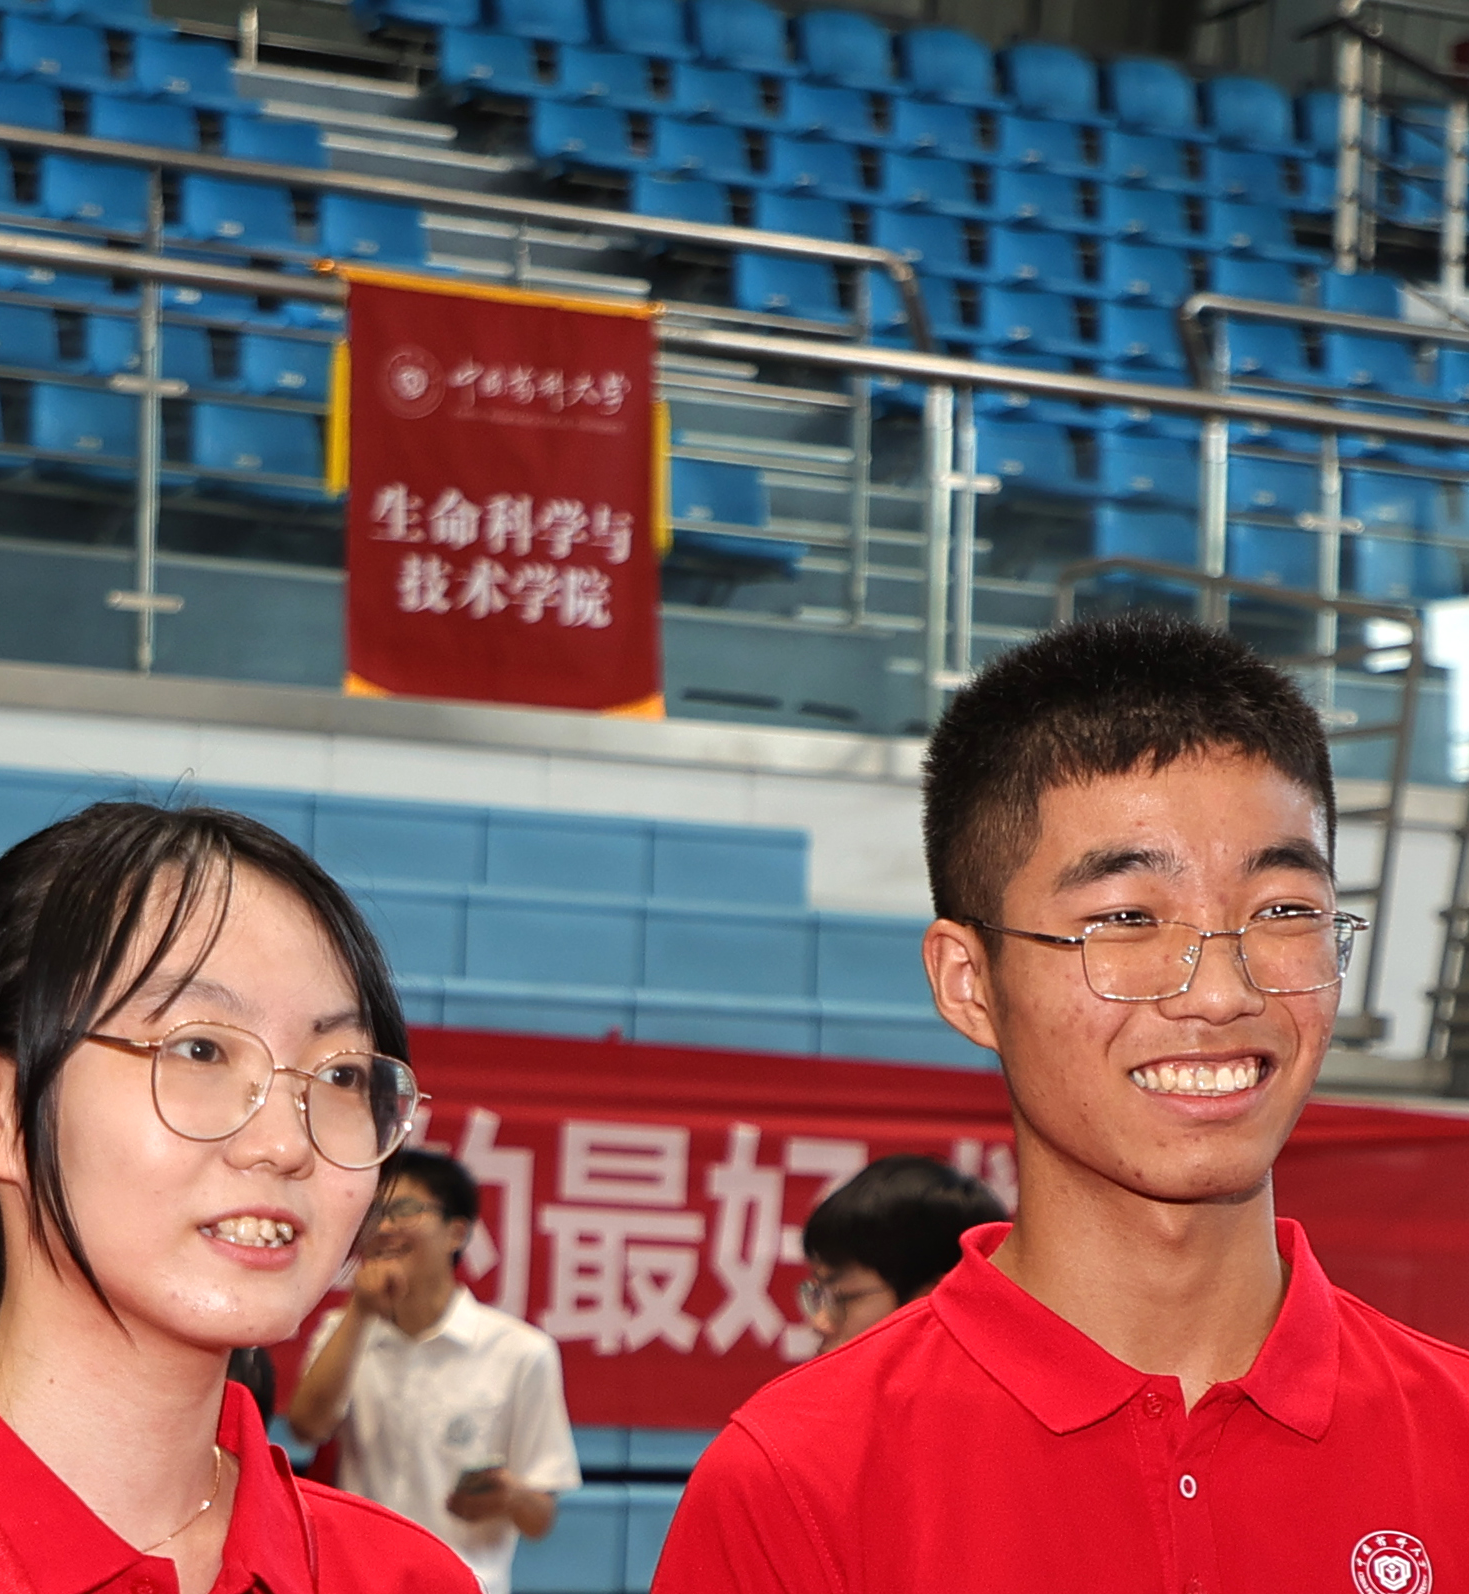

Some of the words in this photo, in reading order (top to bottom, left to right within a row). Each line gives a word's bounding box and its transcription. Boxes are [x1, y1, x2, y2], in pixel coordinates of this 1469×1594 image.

[368, 482, 635, 566] 生命科学与
[396, 551, 614, 630] 技术学院
